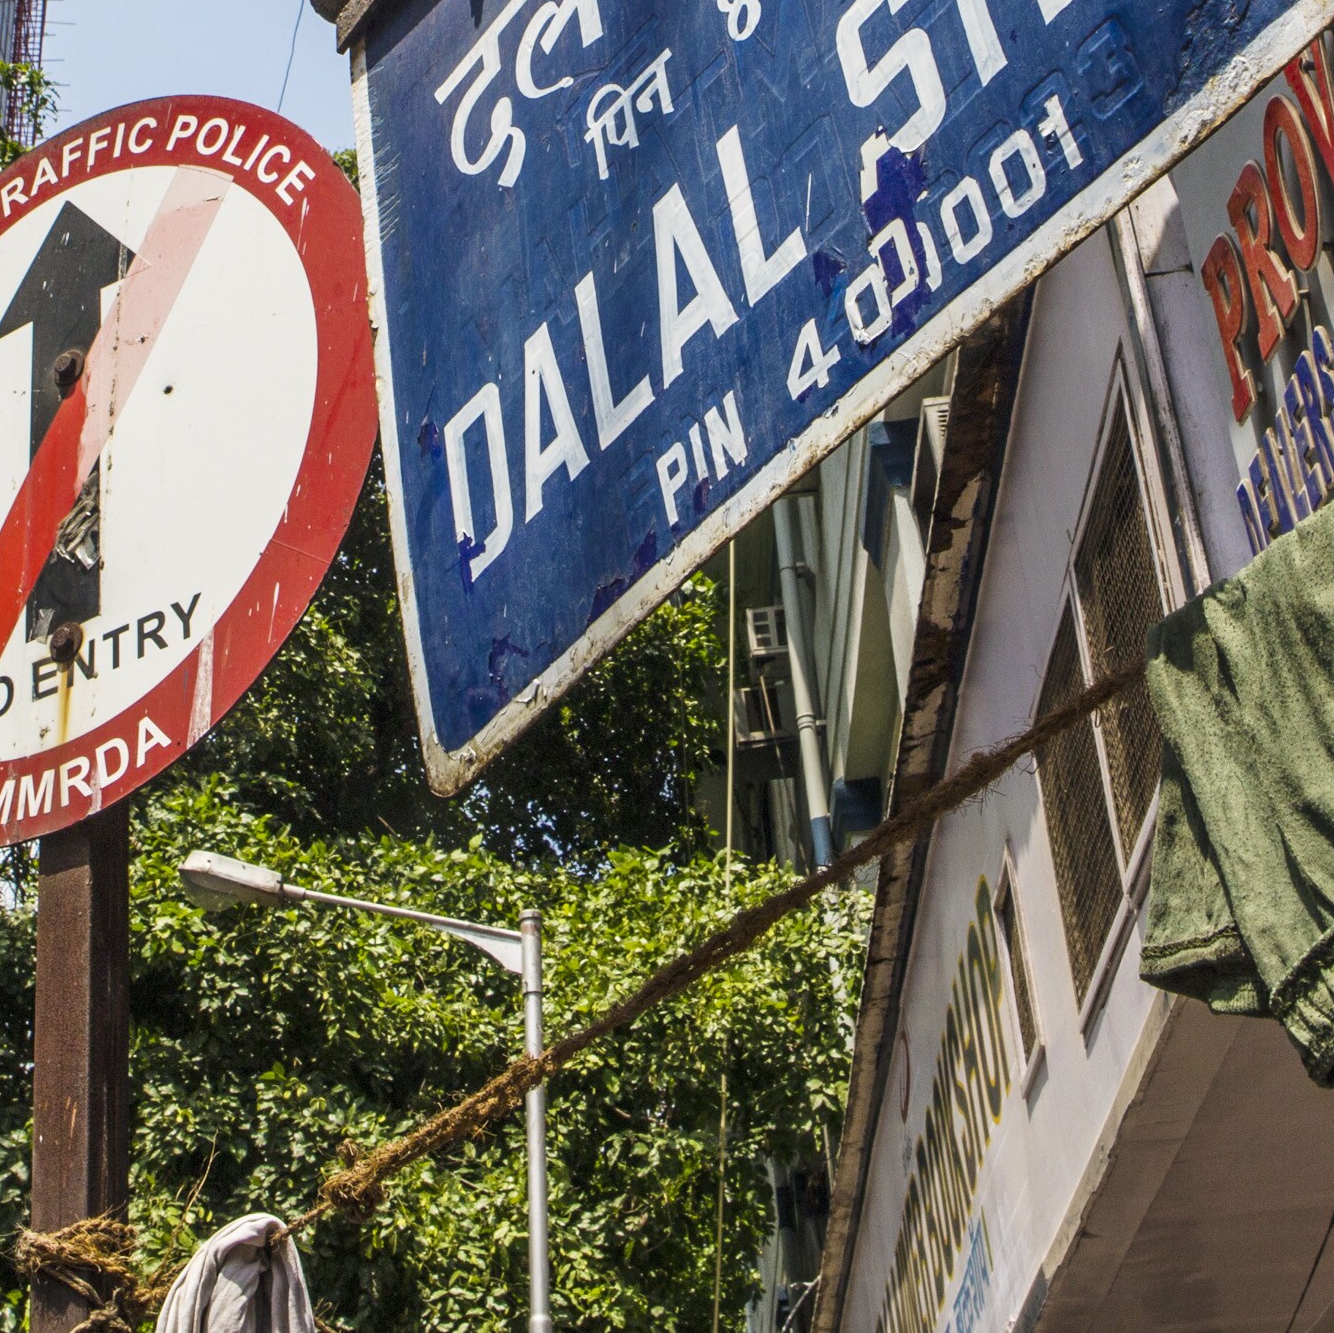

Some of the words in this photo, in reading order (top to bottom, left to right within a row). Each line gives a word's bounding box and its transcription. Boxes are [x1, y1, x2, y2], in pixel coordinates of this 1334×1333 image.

[166, 114, 317, 207] POLICE
[583, 47, 675, 181] पिन
[443, 123, 808, 583] DALAL
[654, 390, 749, 527] PIN
[30, 591, 203, 703] ENTRY
